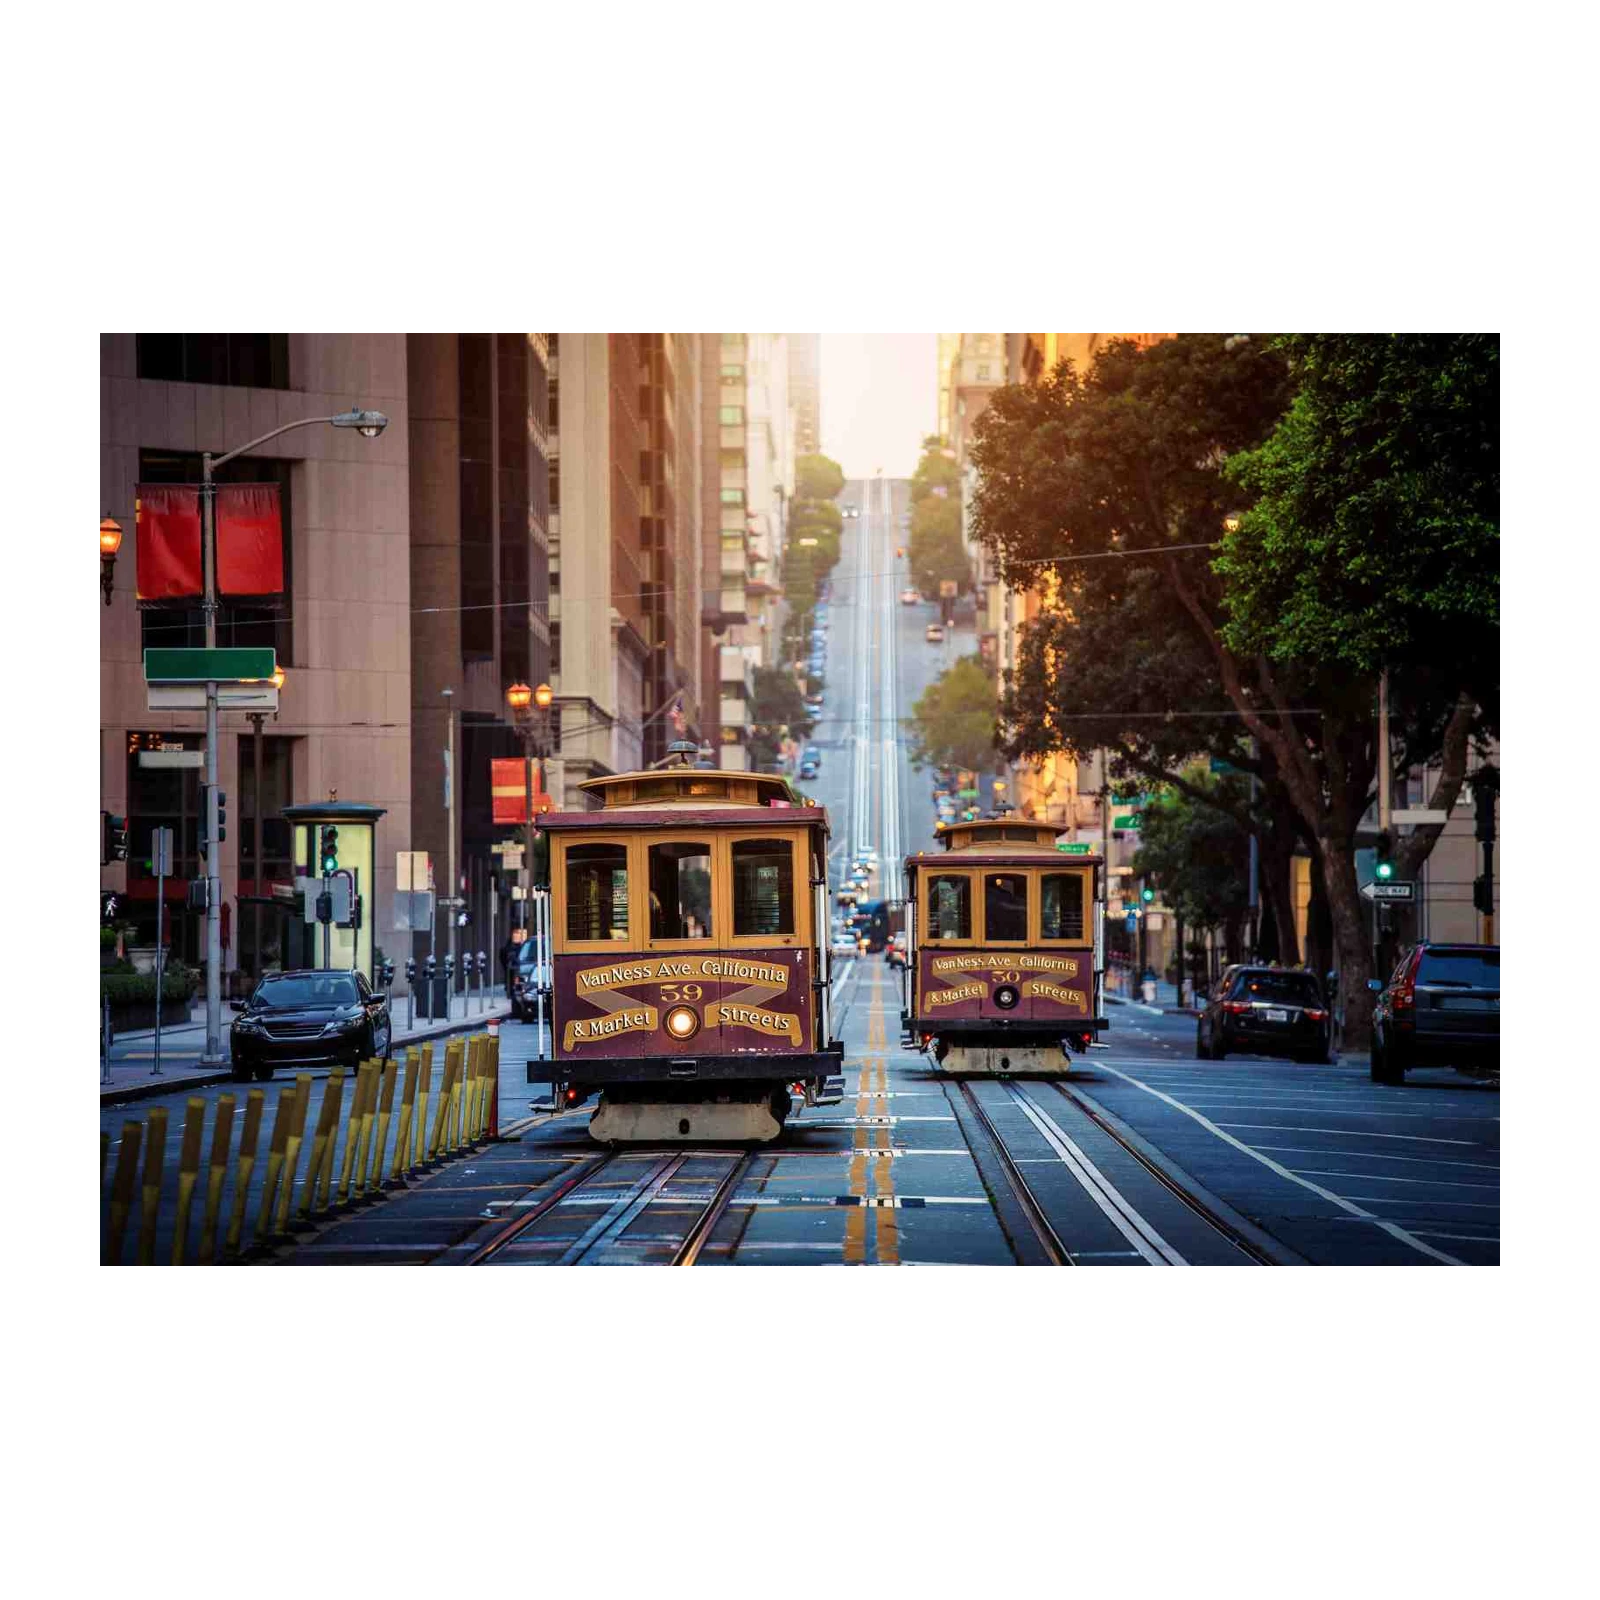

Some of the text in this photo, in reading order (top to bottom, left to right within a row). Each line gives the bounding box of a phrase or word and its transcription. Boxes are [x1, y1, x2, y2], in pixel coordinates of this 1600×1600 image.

[700, 959, 786, 983] California
[1019, 955, 1077, 971] California
[660, 983, 703, 1002] 59
[931, 984, 983, 1003] & Market
[1031, 983, 1081, 1001] Streets
[573, 1011, 651, 1037] & Market
[718, 1006, 790, 1030] Streets
